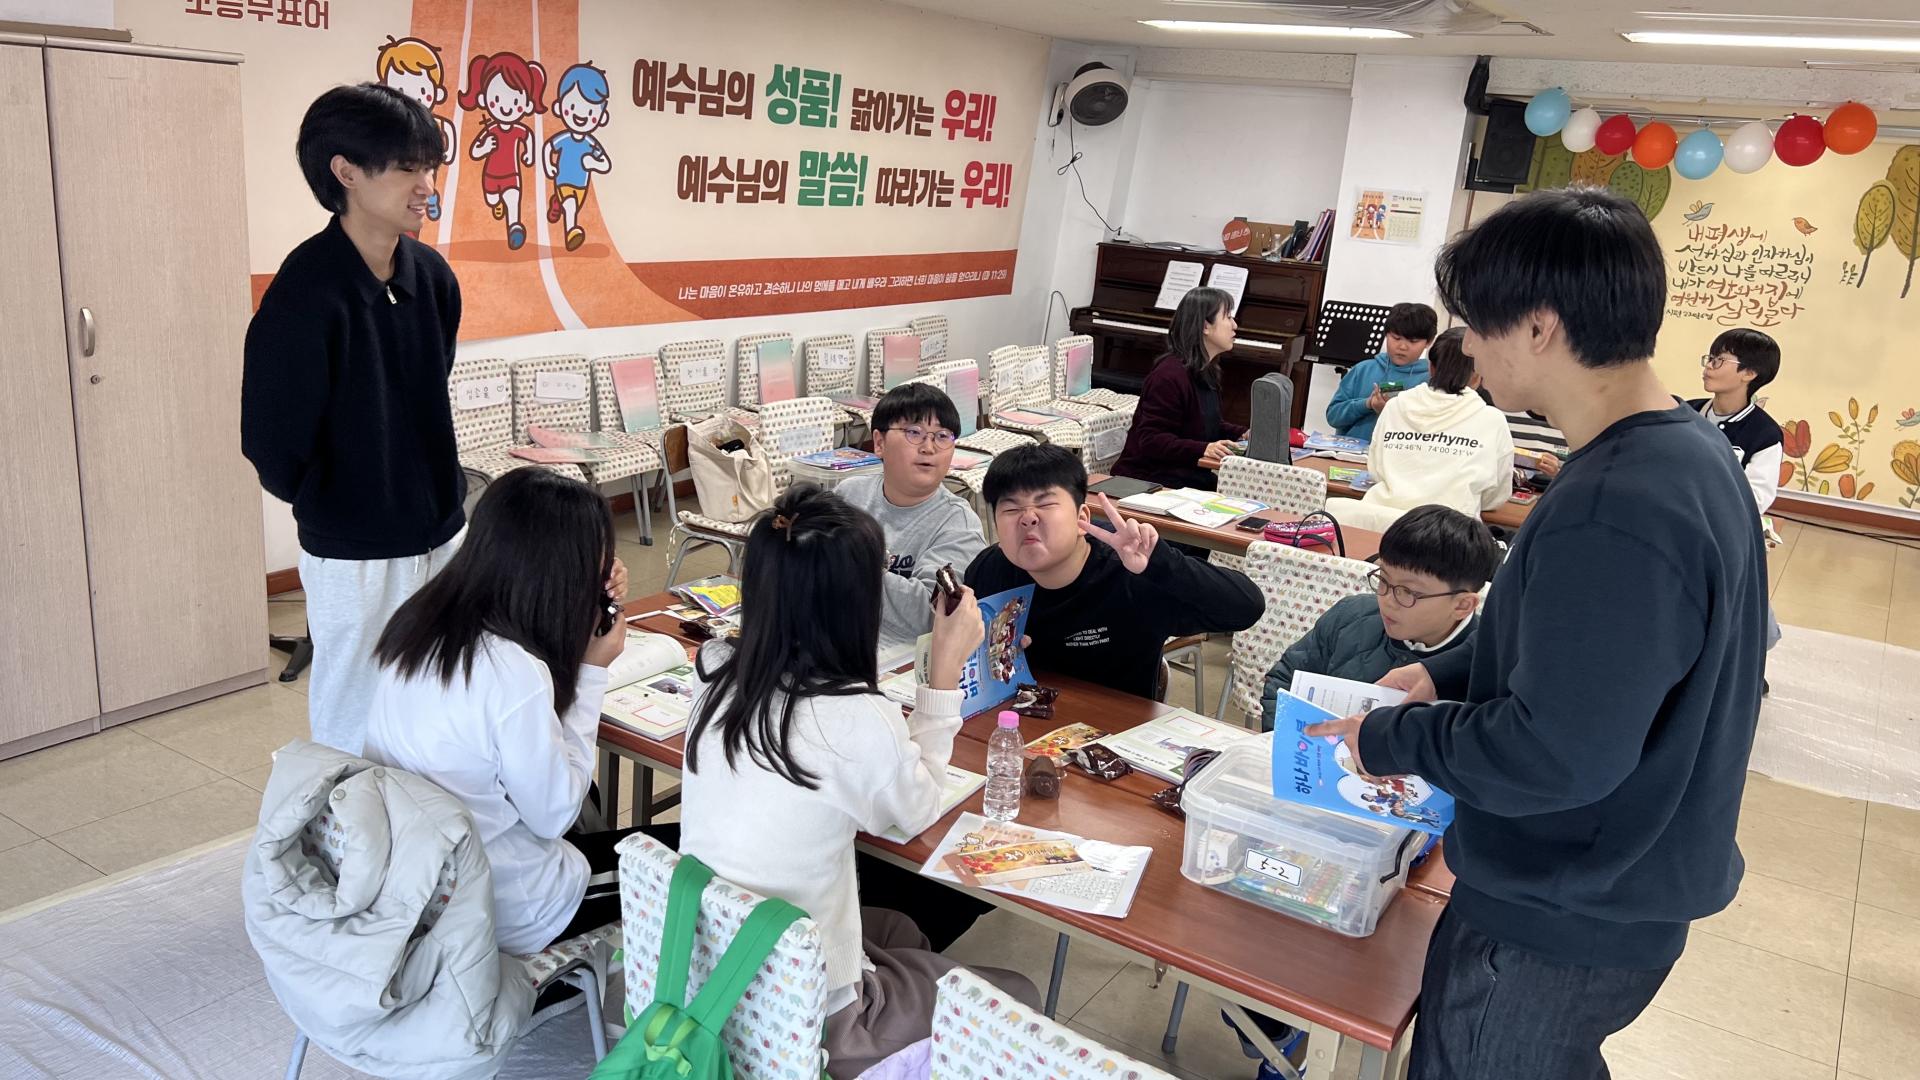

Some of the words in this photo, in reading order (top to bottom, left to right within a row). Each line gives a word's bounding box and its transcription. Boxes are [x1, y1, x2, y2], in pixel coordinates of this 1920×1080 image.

[633, 58, 755, 120] 예수님의
[765, 64, 842, 128] 성품!
[850, 87, 935, 137] 닮아가는
[940, 89, 998, 142] 우리!
[677, 155, 788, 204] 예수님의
[796, 150, 868, 207] 말씀!
[875, 166, 955, 208] 따라가는
[960, 160, 1012, 208] 우리!
[1675, 243, 1748, 262] 선하심과
[1752, 244, 1814, 265] 인자하심이
[1678, 259, 1719, 276] 반드시
[1723, 264, 1756, 282] 나를
[1759, 263, 1812, 284] 따르리니
[678, 286, 698, 300] 나는
[699, 285, 727, 299] 마음이
[728, 283, 762, 297] 온유하고
[763, 281, 796, 295] 겸손하니
[797, 280, 813, 293] 나의
[1671, 291, 1714, 307] 영원히
[1707, 299, 1805, 327] 살리로다
[1261, 857, 1290, 880] 5-2
